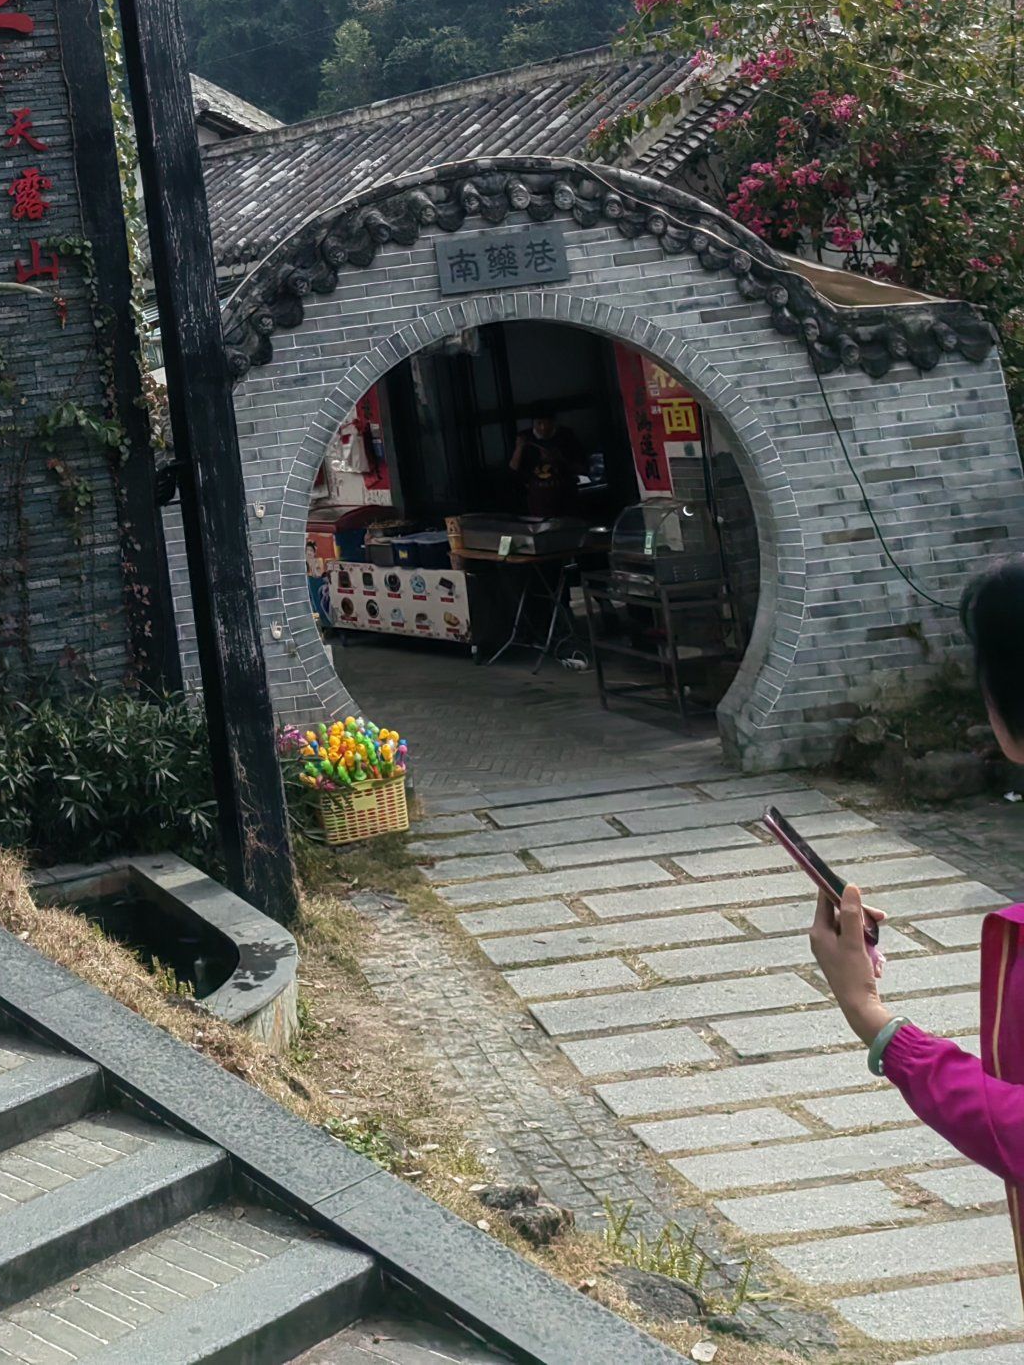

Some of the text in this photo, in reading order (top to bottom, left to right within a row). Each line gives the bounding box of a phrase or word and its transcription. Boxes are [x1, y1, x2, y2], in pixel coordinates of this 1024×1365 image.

[4, 107, 59, 284] 天露山
[447, 239, 557, 284] 南藥巷
